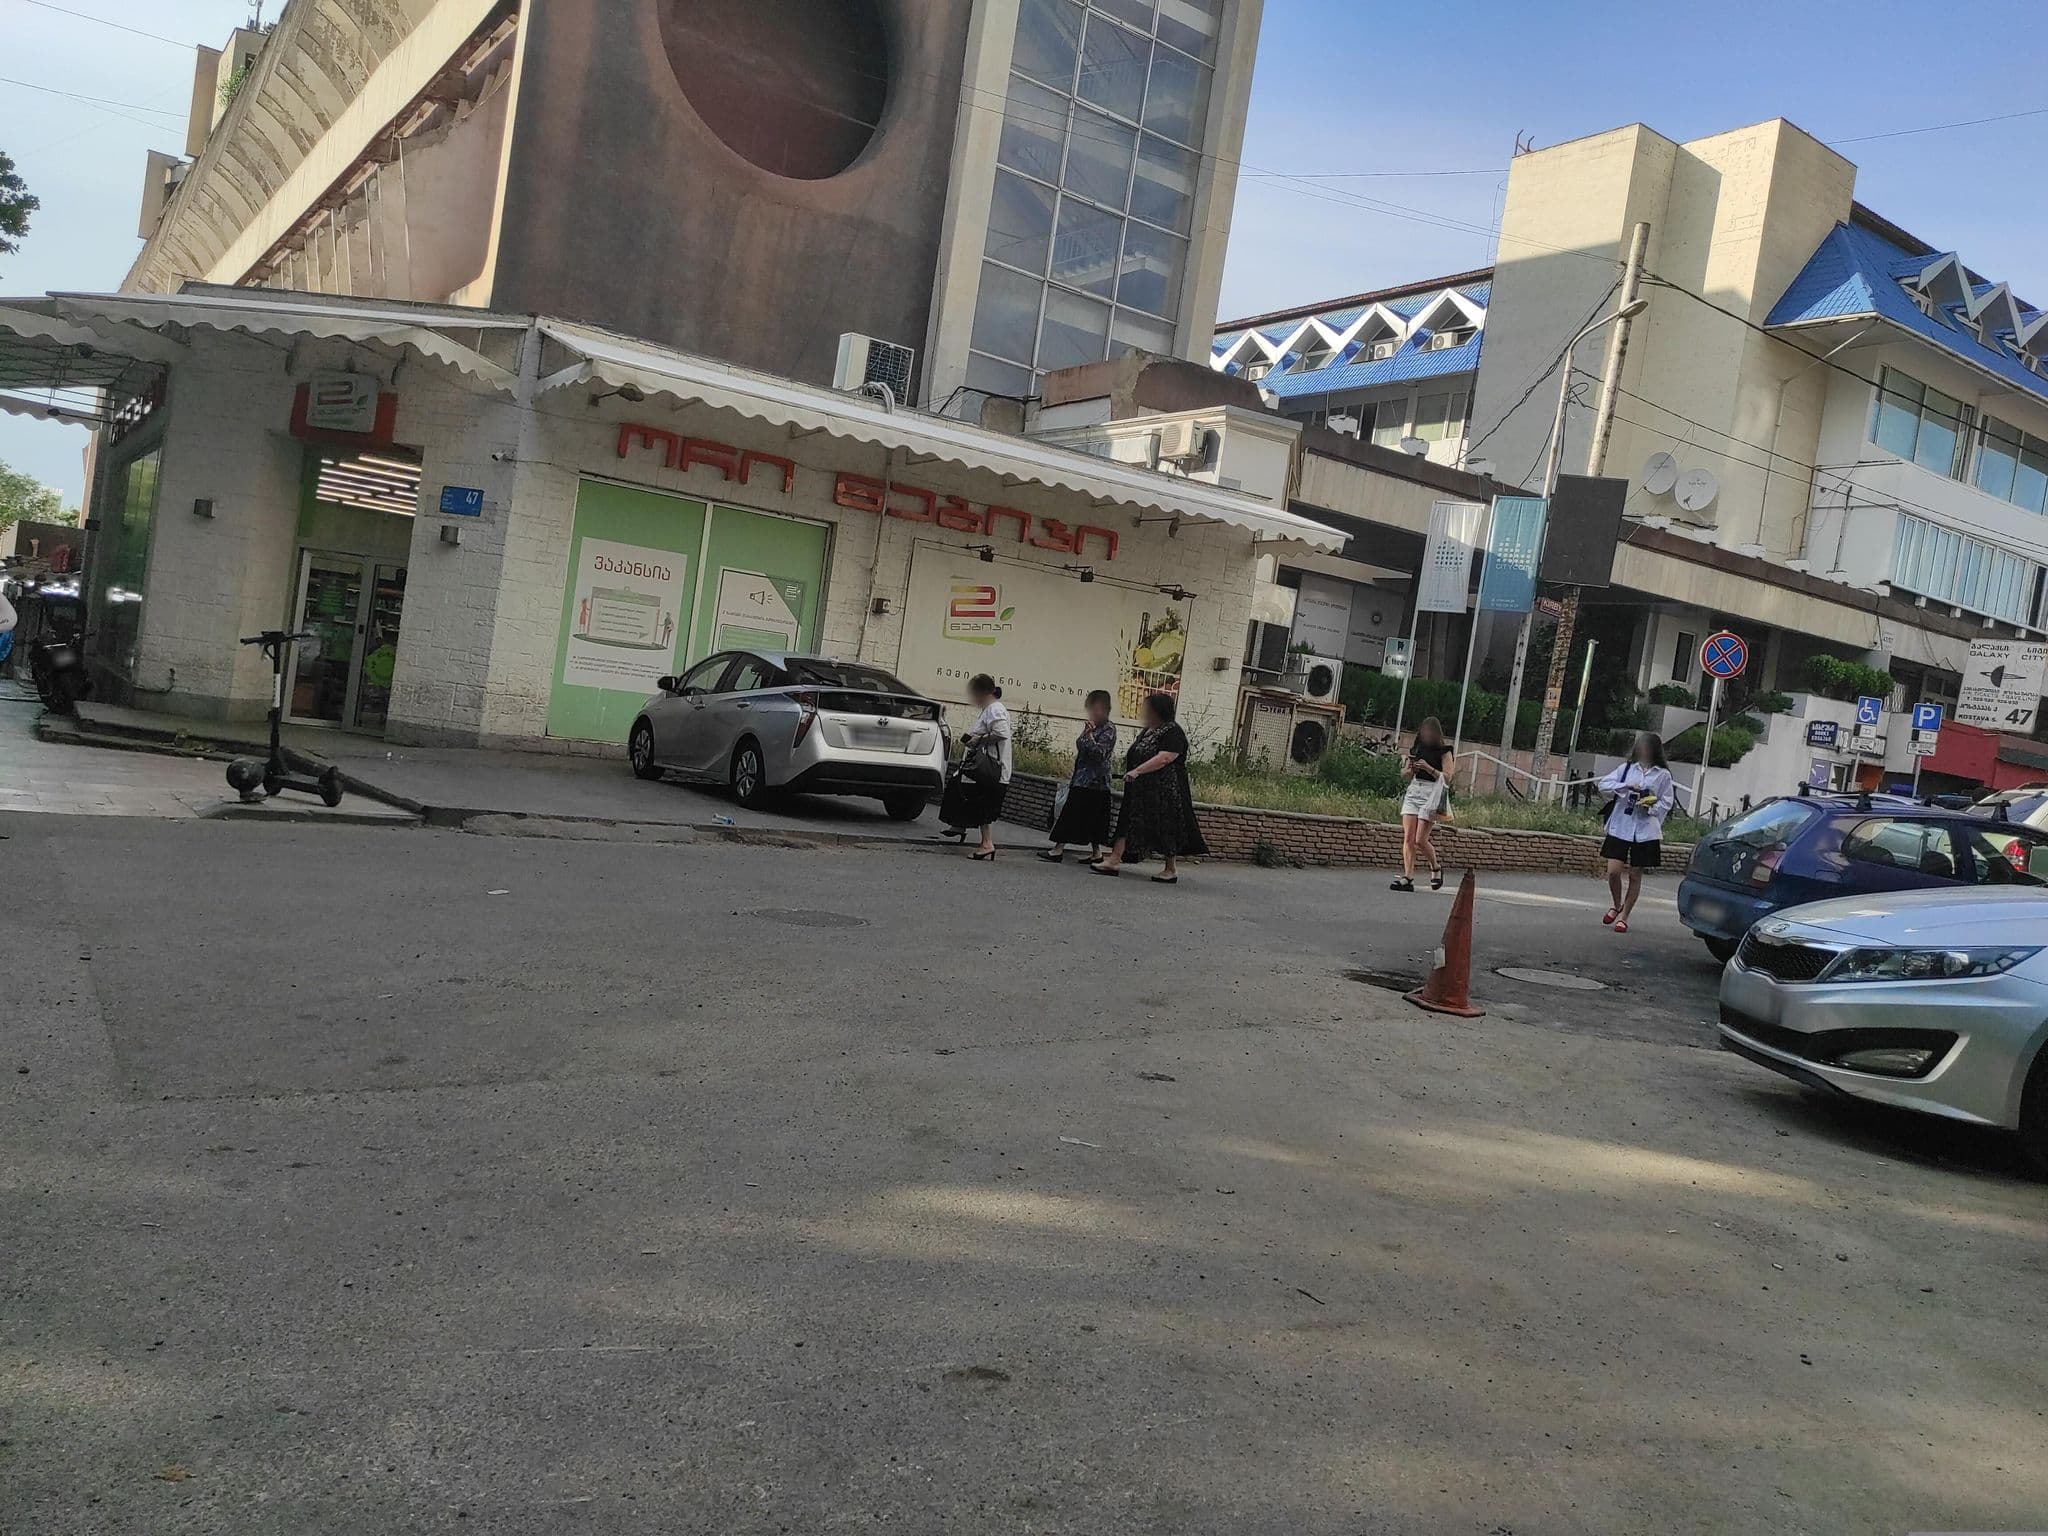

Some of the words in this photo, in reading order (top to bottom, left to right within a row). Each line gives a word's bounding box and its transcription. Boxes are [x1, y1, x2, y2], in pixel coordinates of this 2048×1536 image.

[617, 422, 796, 493] ორი
[466, 490, 479, 504] 47
[594, 555, 671, 581] ვაკანსია
[1542, 600, 1561, 611] KIRBY
[1969, 650, 2010, 659] GALAXY
[936, 667, 970, 680] ჩემი
[1918, 706, 1936, 727] P
[1958, 714, 1990, 722] KOSTAVA
[2005, 708, 2033, 725] 47
